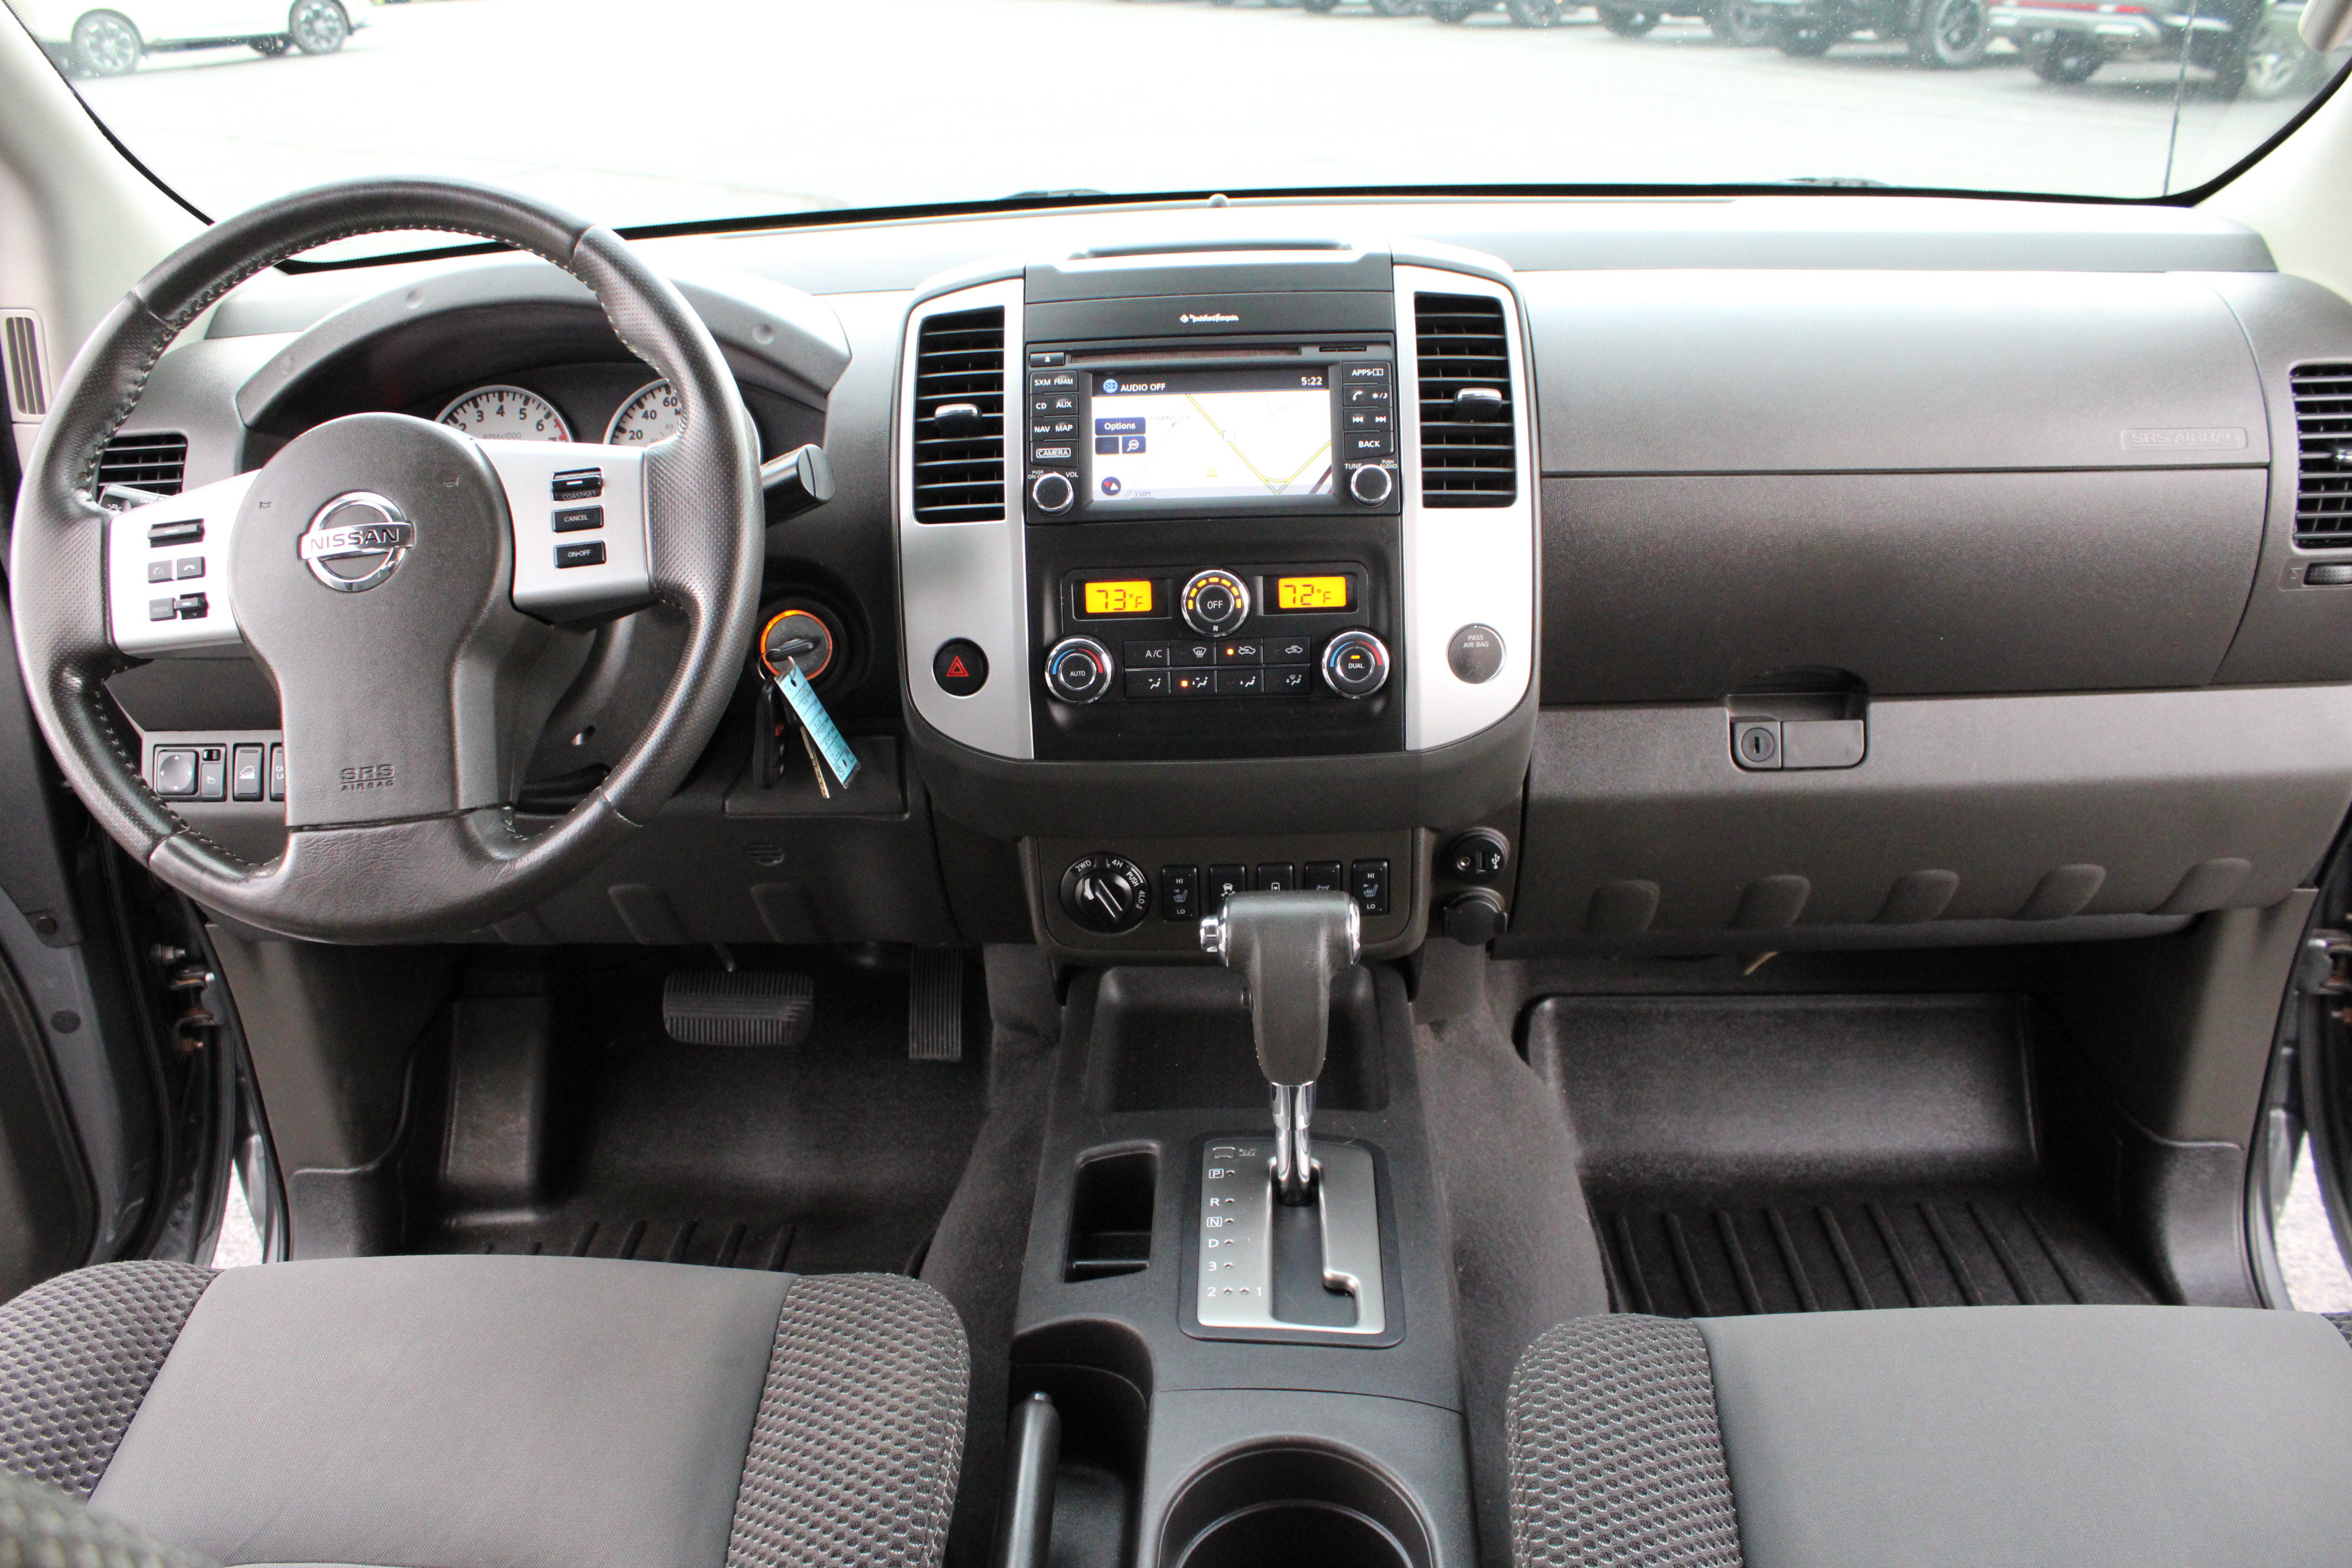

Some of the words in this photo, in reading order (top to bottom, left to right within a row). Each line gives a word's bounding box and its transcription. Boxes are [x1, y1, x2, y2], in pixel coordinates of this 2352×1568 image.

[1301, 376, 1322, 386] 5:22
[663, 396, 678, 407] 60
[476, 410, 485, 422] 3
[496, 404, 505, 417] 4
[520, 408, 527, 420] 5
[642, 410, 657, 420] 40
[536, 419, 544, 432] 6
[1104, 422, 1136, 431] Options
[629, 430, 643, 440] 20
[564, 514, 589, 522] CANCEL
[311, 528, 399, 552] NISSAN
[1207, 600, 1223, 609] OFF
[1145, 650, 1162, 658] A/C
[341, 765, 394, 780] SRS
[341, 780, 394, 792] AIRBAG
[1075, 860, 1092, 872] 2WD
[1111, 859, 1123, 868] 4H
[1126, 871, 1140, 887] PUSH
[1210, 1197, 1220, 1206] R
[1208, 1239, 1219, 1248] D
[1208, 1261, 1217, 1272] 3
[1207, 1286, 1217, 1297] 2
[1256, 1286, 1262, 1297] 1
